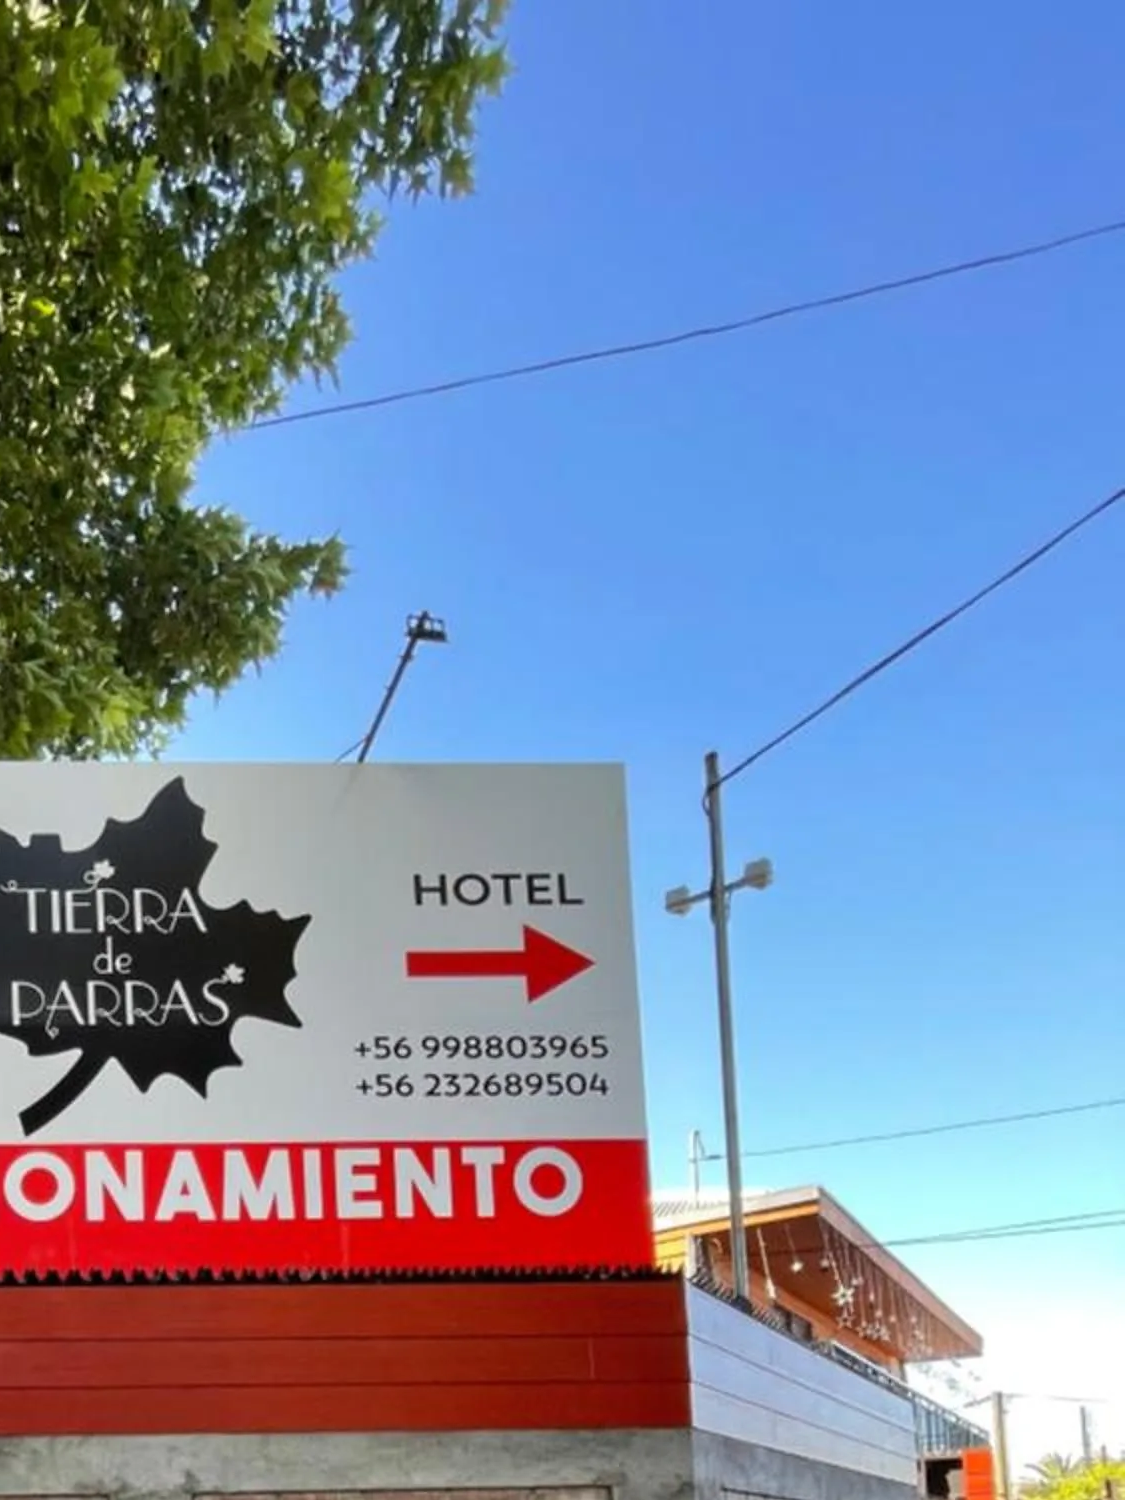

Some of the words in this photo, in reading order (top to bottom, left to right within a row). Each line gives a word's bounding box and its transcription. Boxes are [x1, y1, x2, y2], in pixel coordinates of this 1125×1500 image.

[412, 872, 585, 907] HOTEL
[2, 883, 208, 934] TIERRA
[92, 935, 134, 974] de
[9, 978, 234, 1032] PARRAS
[354, 1035, 413, 1060] +56
[421, 1034, 610, 1059] 998803965
[355, 1073, 415, 1098] +56
[424, 1072, 610, 1097] 232689504
